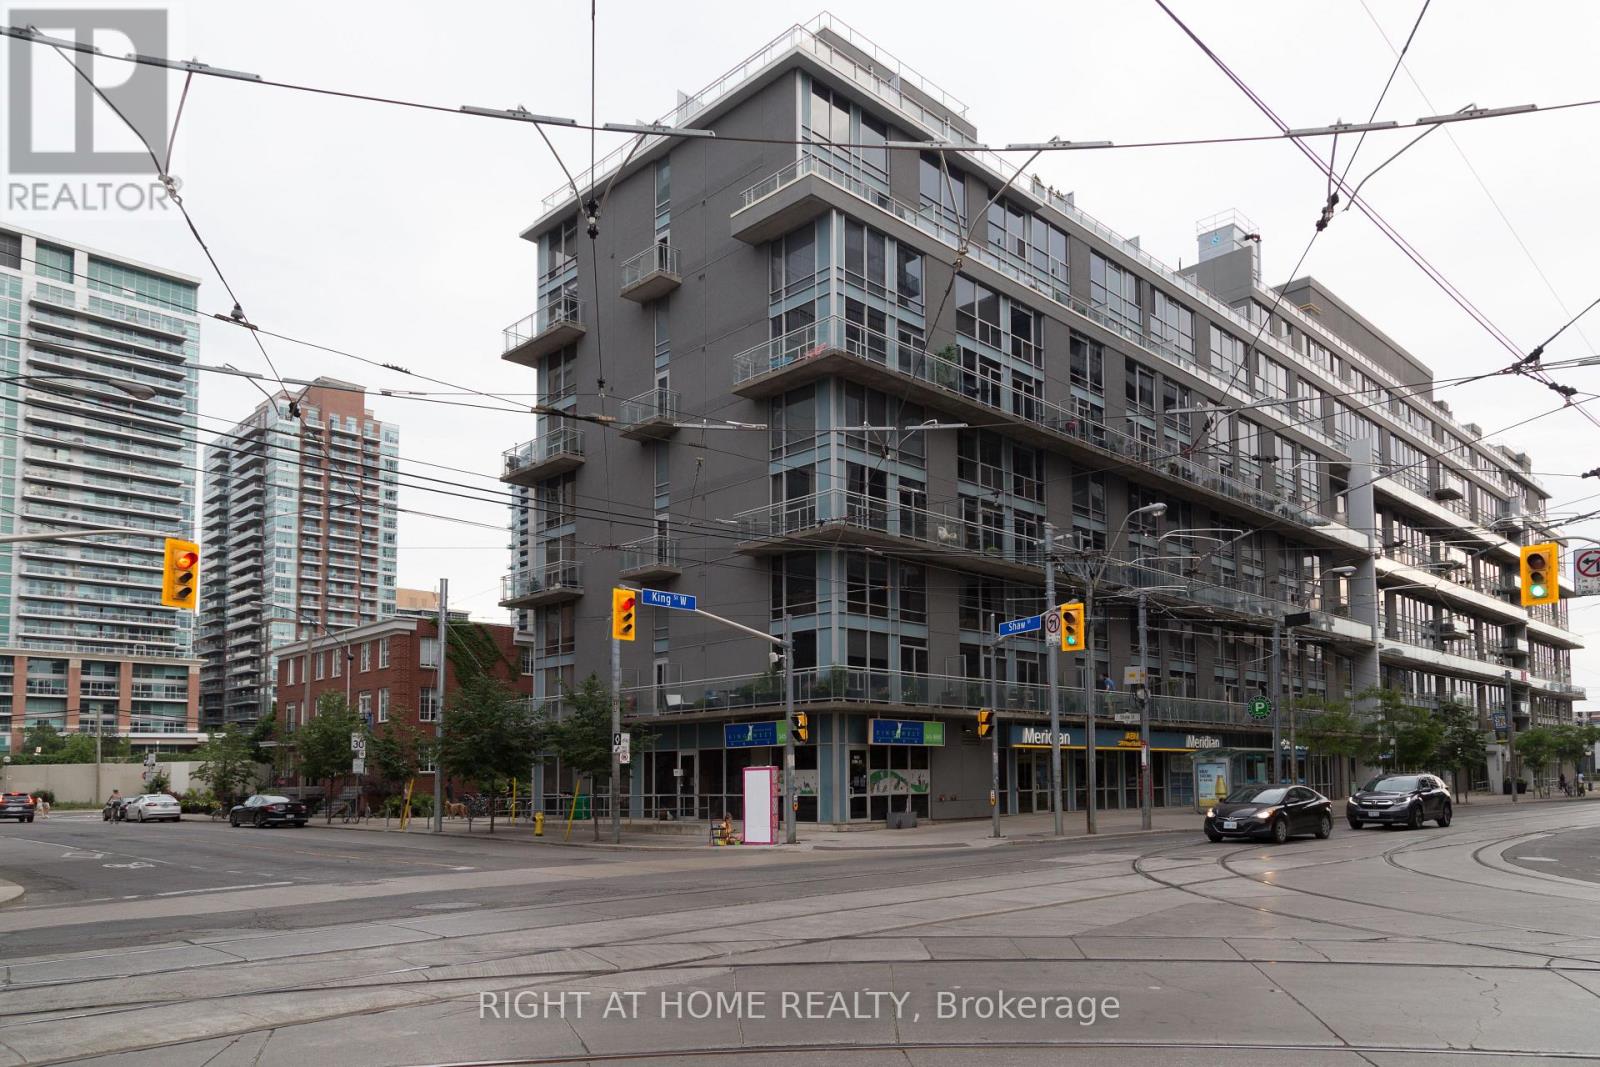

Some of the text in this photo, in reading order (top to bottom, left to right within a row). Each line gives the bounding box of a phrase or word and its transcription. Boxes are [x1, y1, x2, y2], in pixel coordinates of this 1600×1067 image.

[651, 591, 671, 606] King
[680, 595, 687, 606] W
[1008, 620, 1026, 632] Shaw
[1255, 702, 1265, 712] P
[353, 740, 364, 748] 30
[1185, 734, 1220, 749] Meridian
